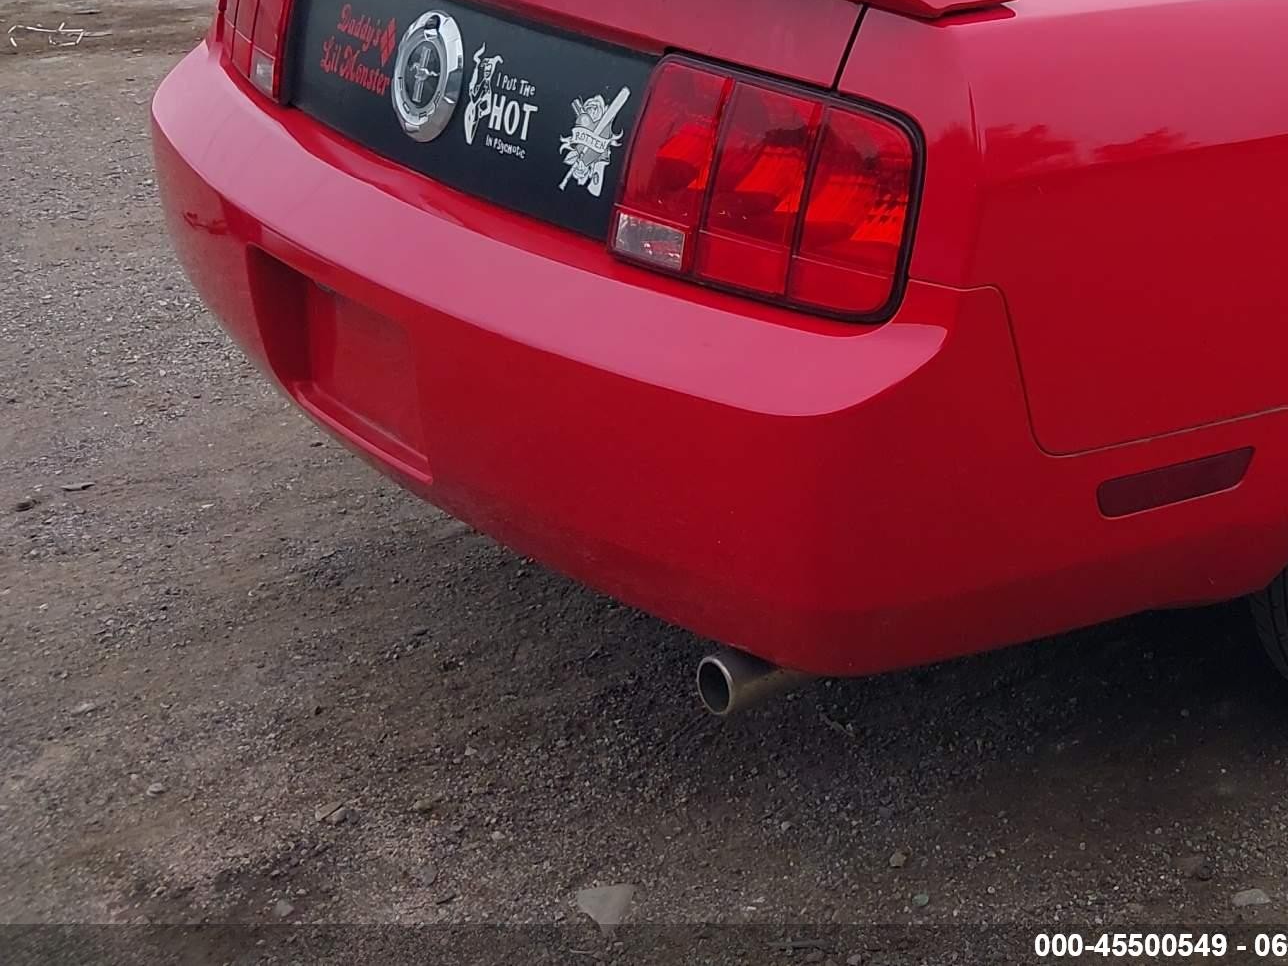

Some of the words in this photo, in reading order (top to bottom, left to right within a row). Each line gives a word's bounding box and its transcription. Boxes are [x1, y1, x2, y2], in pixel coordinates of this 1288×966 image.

[337, 3, 382, 52] Daddy's
[340, 45, 390, 95] Monster
[496, 72, 502, 87] I
[488, 94, 538, 141] HOT
[575, 131, 607, 152] ROTTEN
